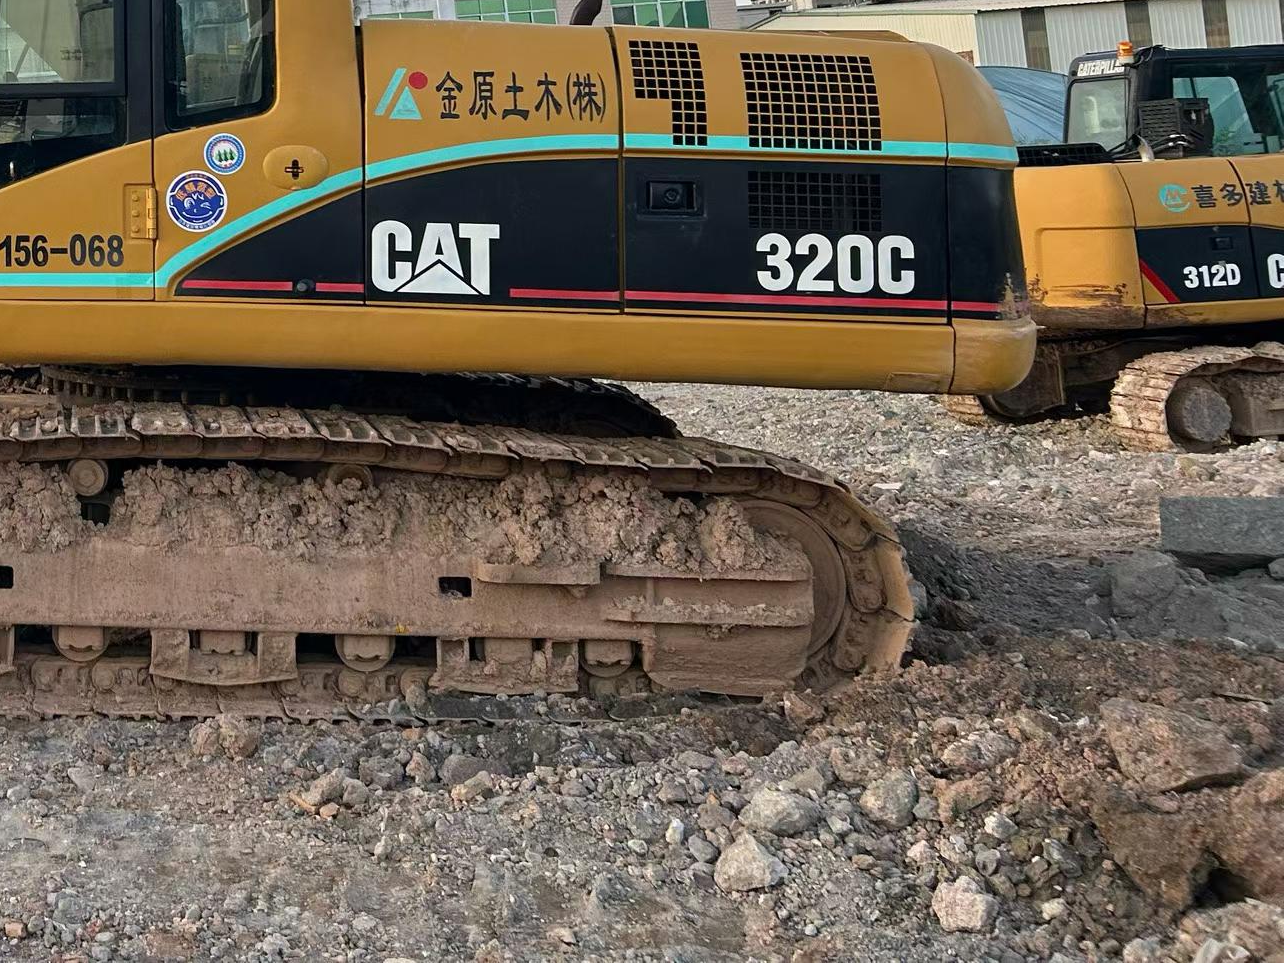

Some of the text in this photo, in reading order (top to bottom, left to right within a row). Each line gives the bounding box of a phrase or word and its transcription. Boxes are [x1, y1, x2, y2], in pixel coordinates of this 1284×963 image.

[435, 71, 607, 123] 金原土木(株)
[371, 220, 500, 296] CAT
[755, 233, 915, 295] 320C
[1183, 262, 1241, 288] 312D
